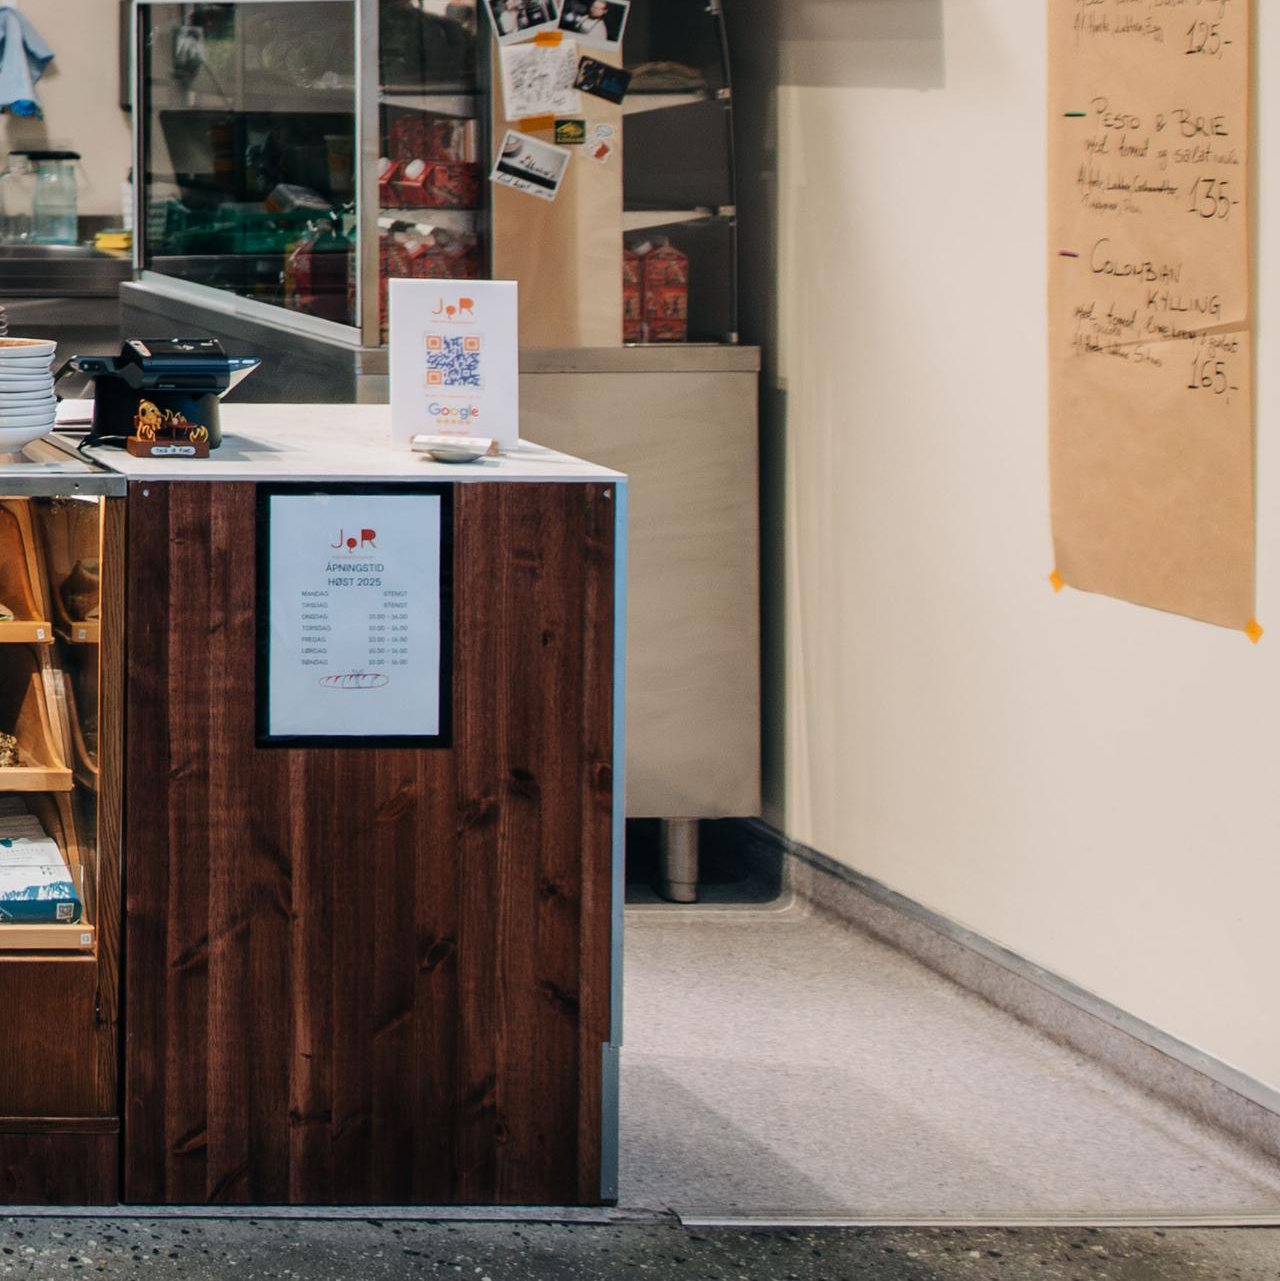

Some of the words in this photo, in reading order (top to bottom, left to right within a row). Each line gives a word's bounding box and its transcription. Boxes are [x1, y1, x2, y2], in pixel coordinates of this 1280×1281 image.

[1171, 109, 1229, 138] BRIE
[1146, 295, 1221, 319] KYLLING
[428, 402, 480, 420] Google
[325, 561, 385, 573] ÅPNINGSTID
[327, 577, 354, 587] HØST
[356, 577, 382, 587] 2025
